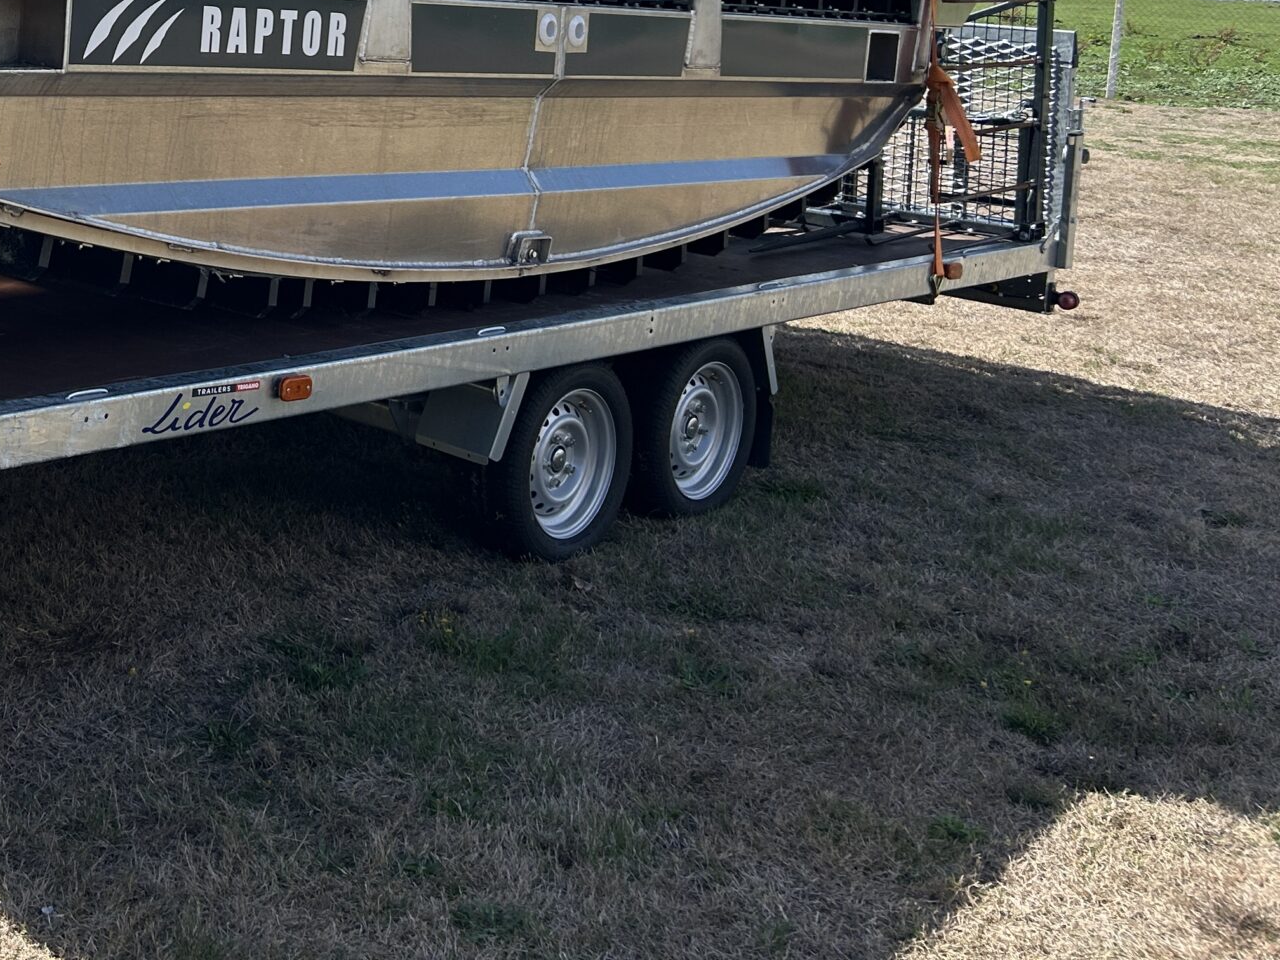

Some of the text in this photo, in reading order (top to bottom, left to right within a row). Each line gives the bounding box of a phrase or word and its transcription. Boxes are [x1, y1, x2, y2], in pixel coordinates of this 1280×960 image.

[200, 5, 347, 57] RAPTOR
[197, 385, 231, 396] TRAILERS
[142, 393, 259, 434] Lider
